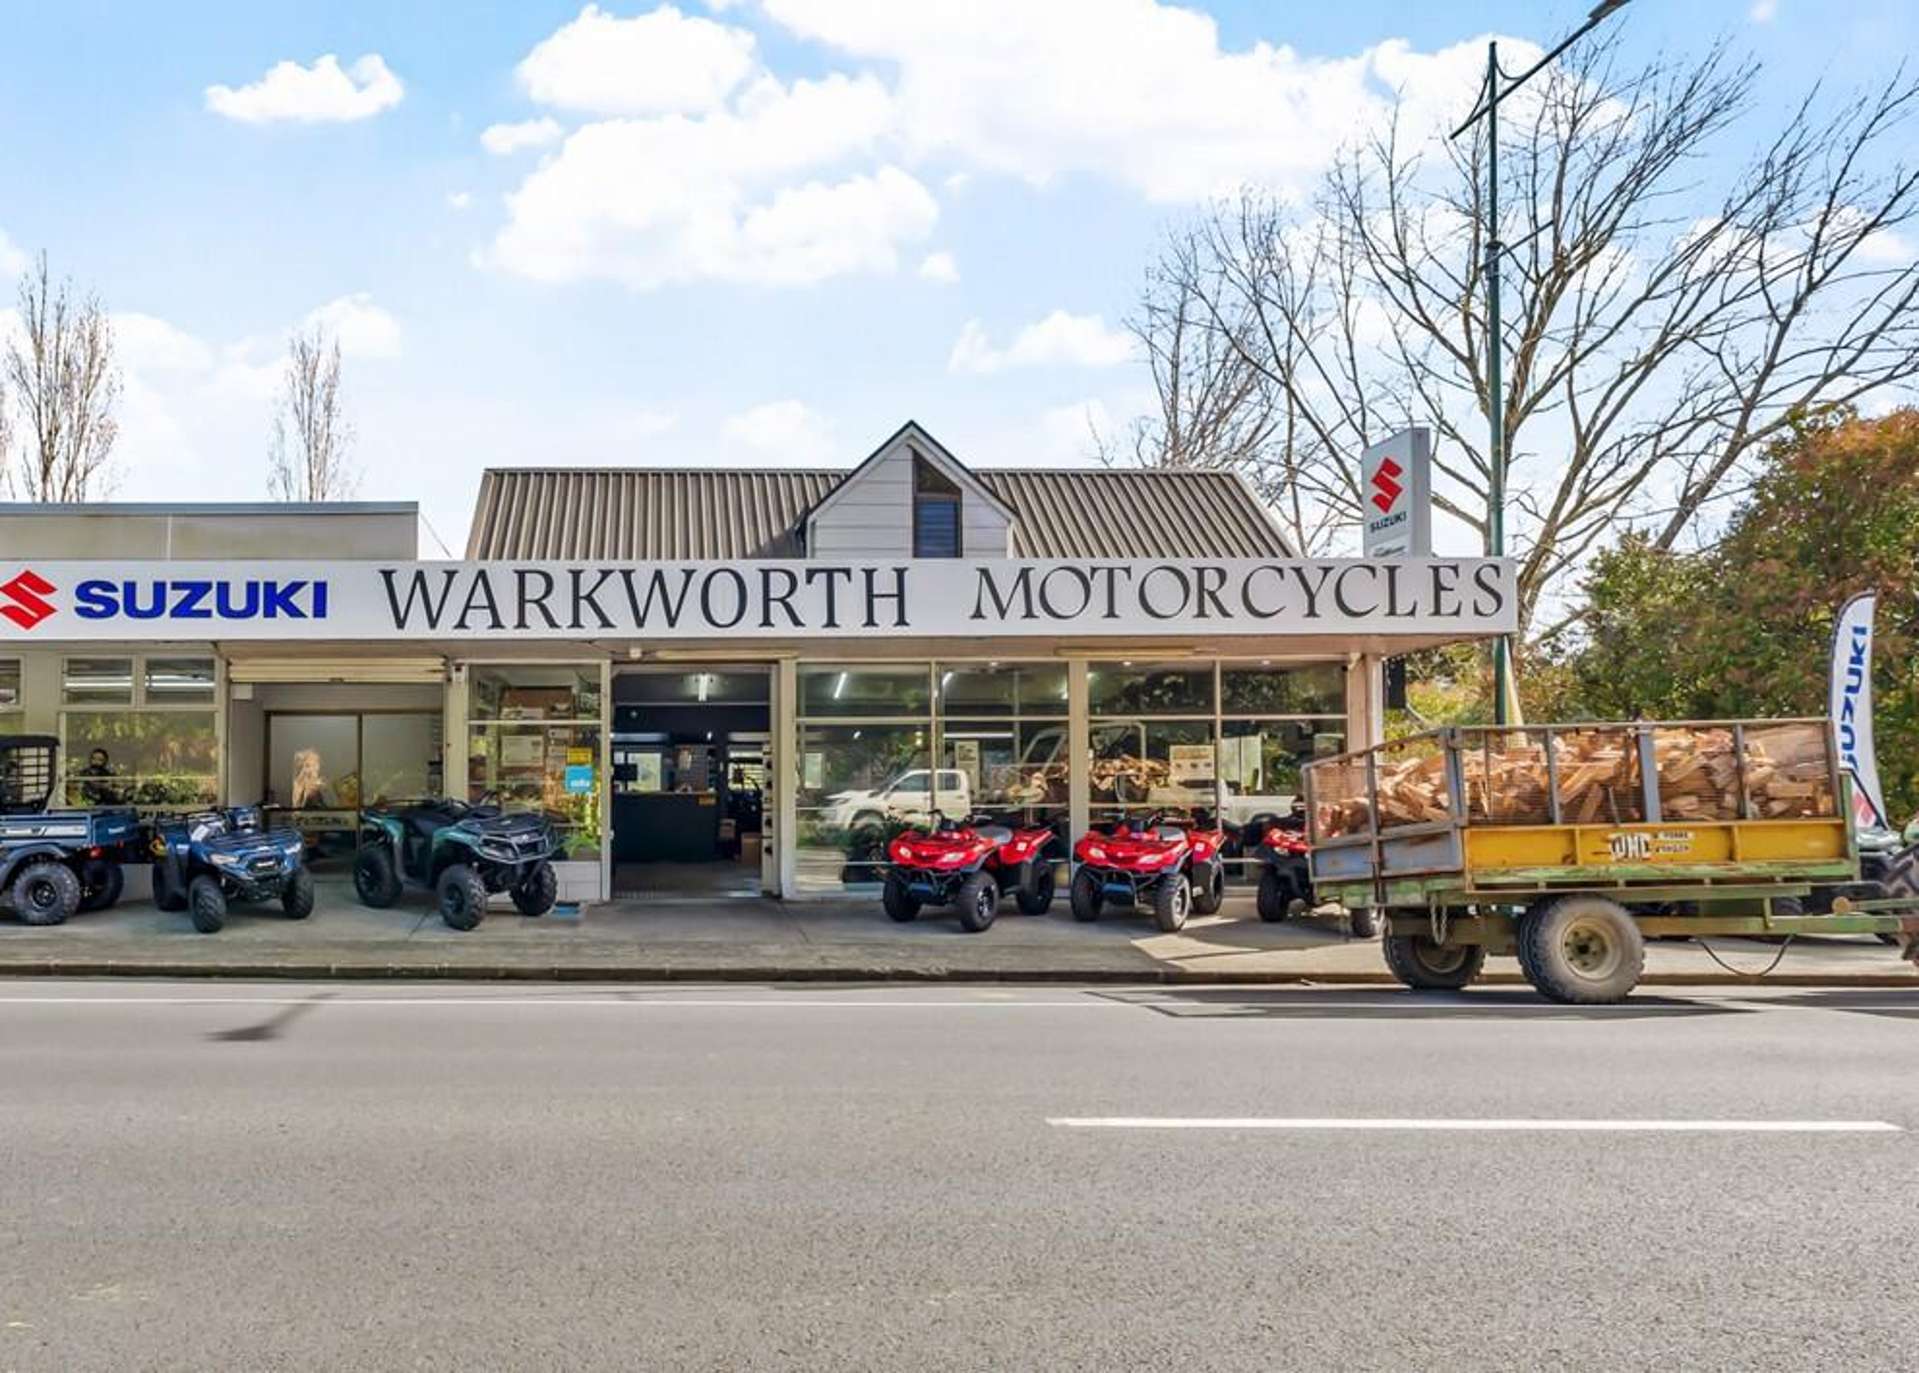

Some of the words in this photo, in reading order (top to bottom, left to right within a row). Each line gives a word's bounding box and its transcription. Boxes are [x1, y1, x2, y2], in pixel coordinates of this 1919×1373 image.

[1370, 511, 1407, 533] SUZUKI
[75, 580, 328, 619] SUZUKI
[380, 568, 909, 629] WARKWORTH
[970, 563, 1503, 619] MOTORCYCLES
